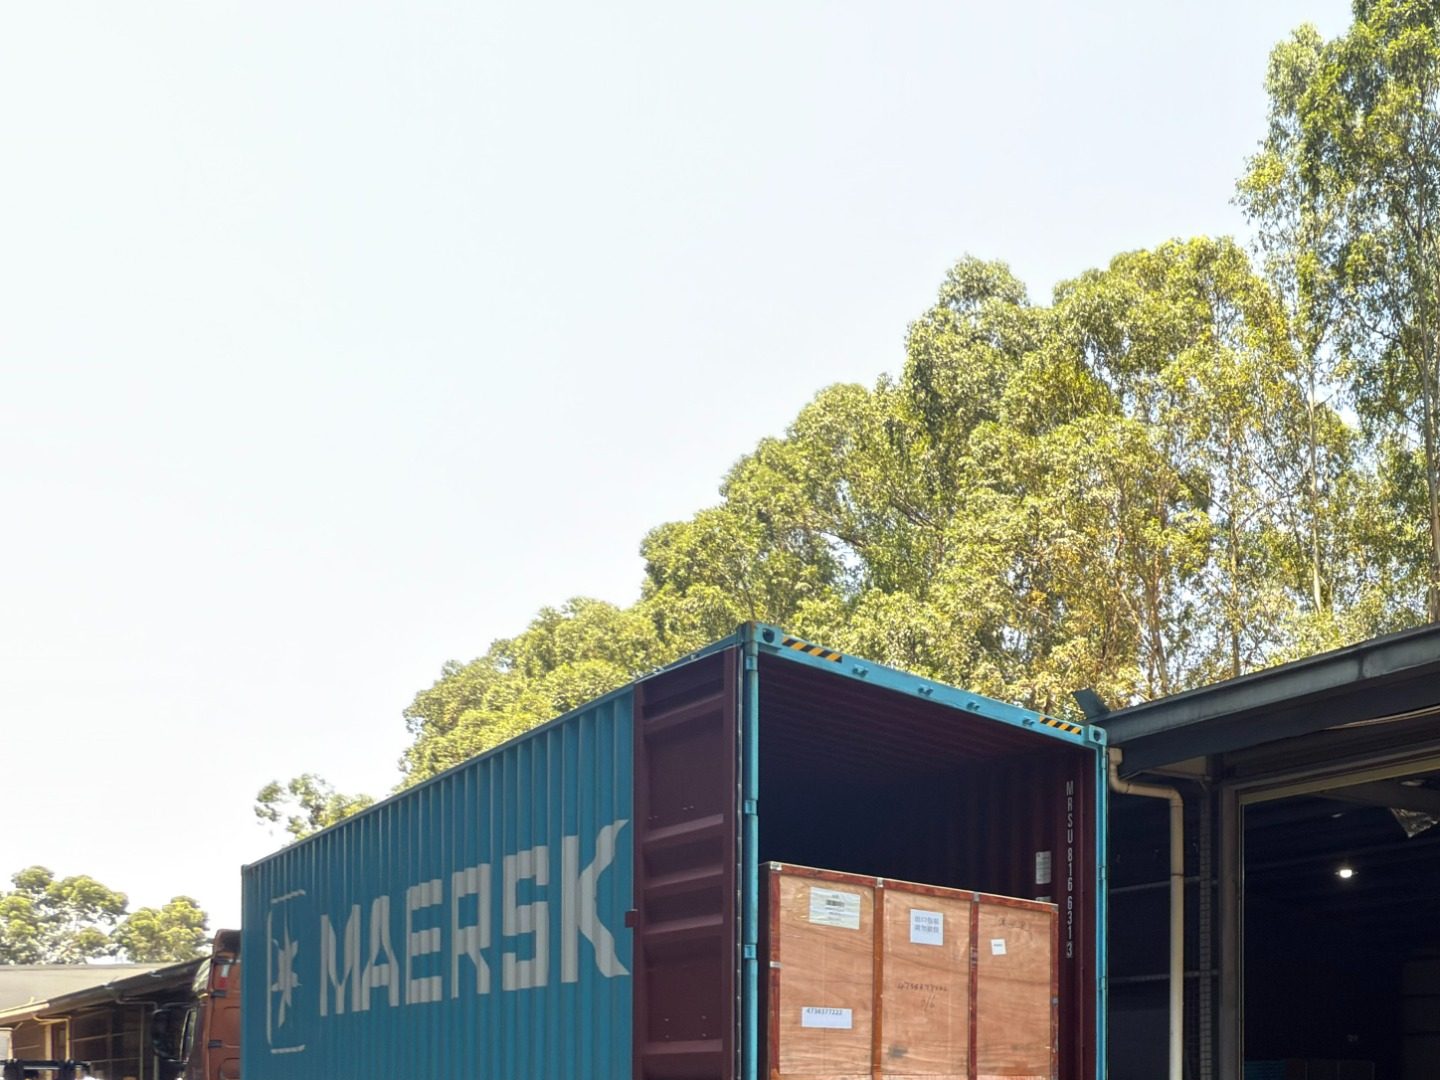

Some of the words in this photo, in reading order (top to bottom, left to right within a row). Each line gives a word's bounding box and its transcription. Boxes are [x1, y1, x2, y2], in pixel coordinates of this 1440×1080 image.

[1065, 780, 1075, 844] MRSU
[1066, 847, 1074, 892] 816
[319, 818, 631, 1017] MAERSK
